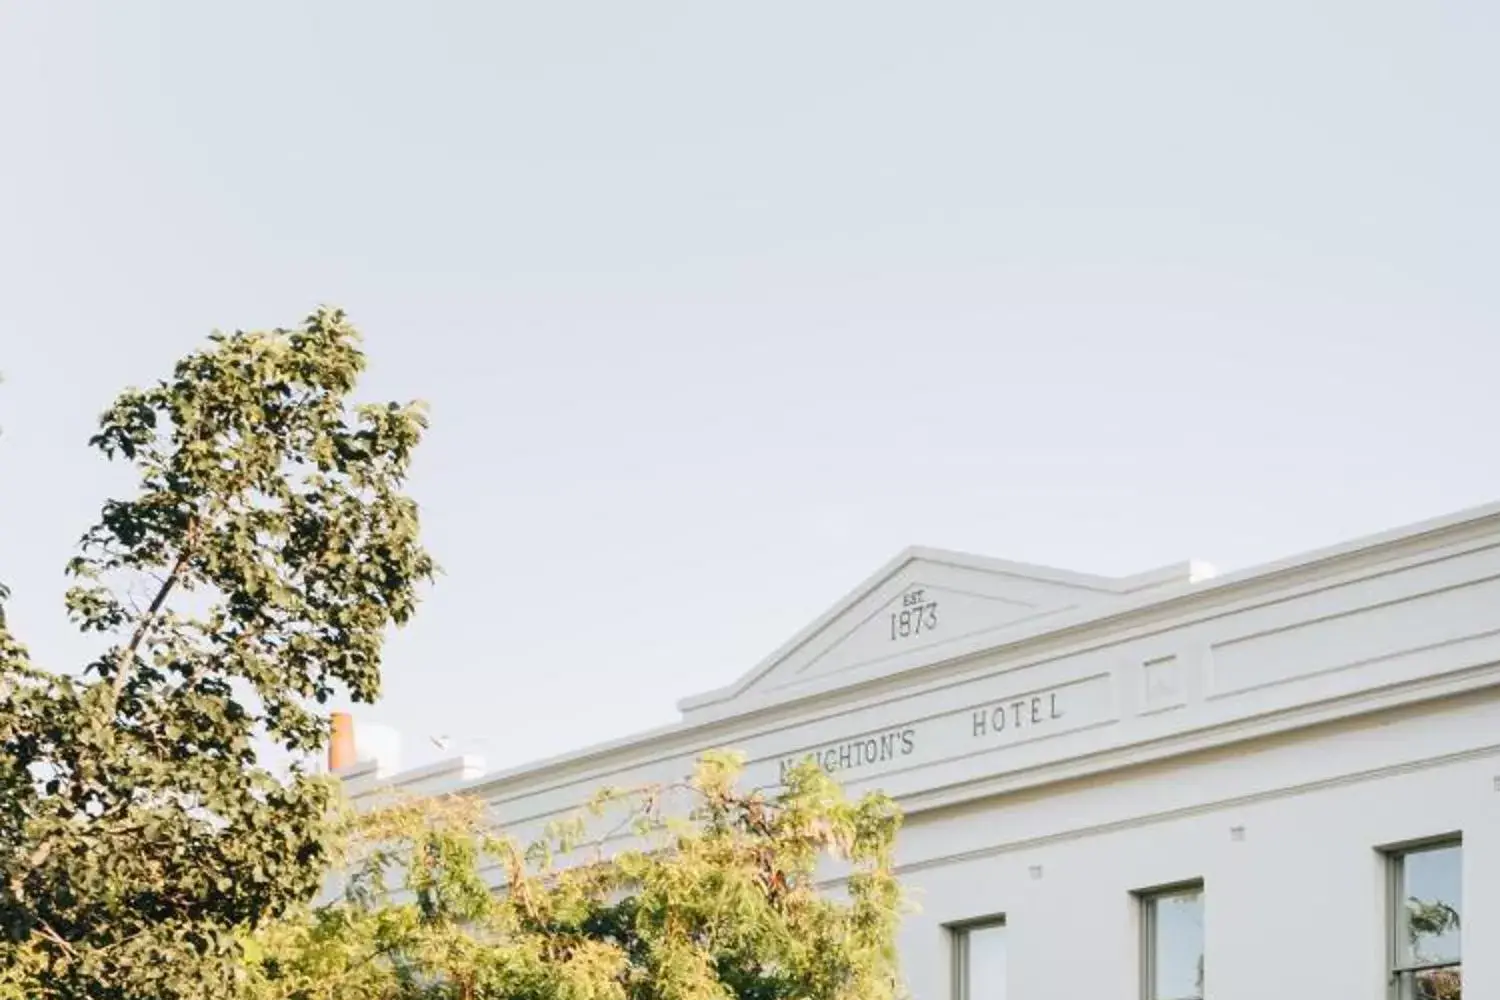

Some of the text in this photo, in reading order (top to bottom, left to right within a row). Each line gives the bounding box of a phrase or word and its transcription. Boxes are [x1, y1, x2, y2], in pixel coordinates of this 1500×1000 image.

[891, 602, 938, 641] 1873
[779, 693, 1066, 787] NGHTON'S HOTEL
